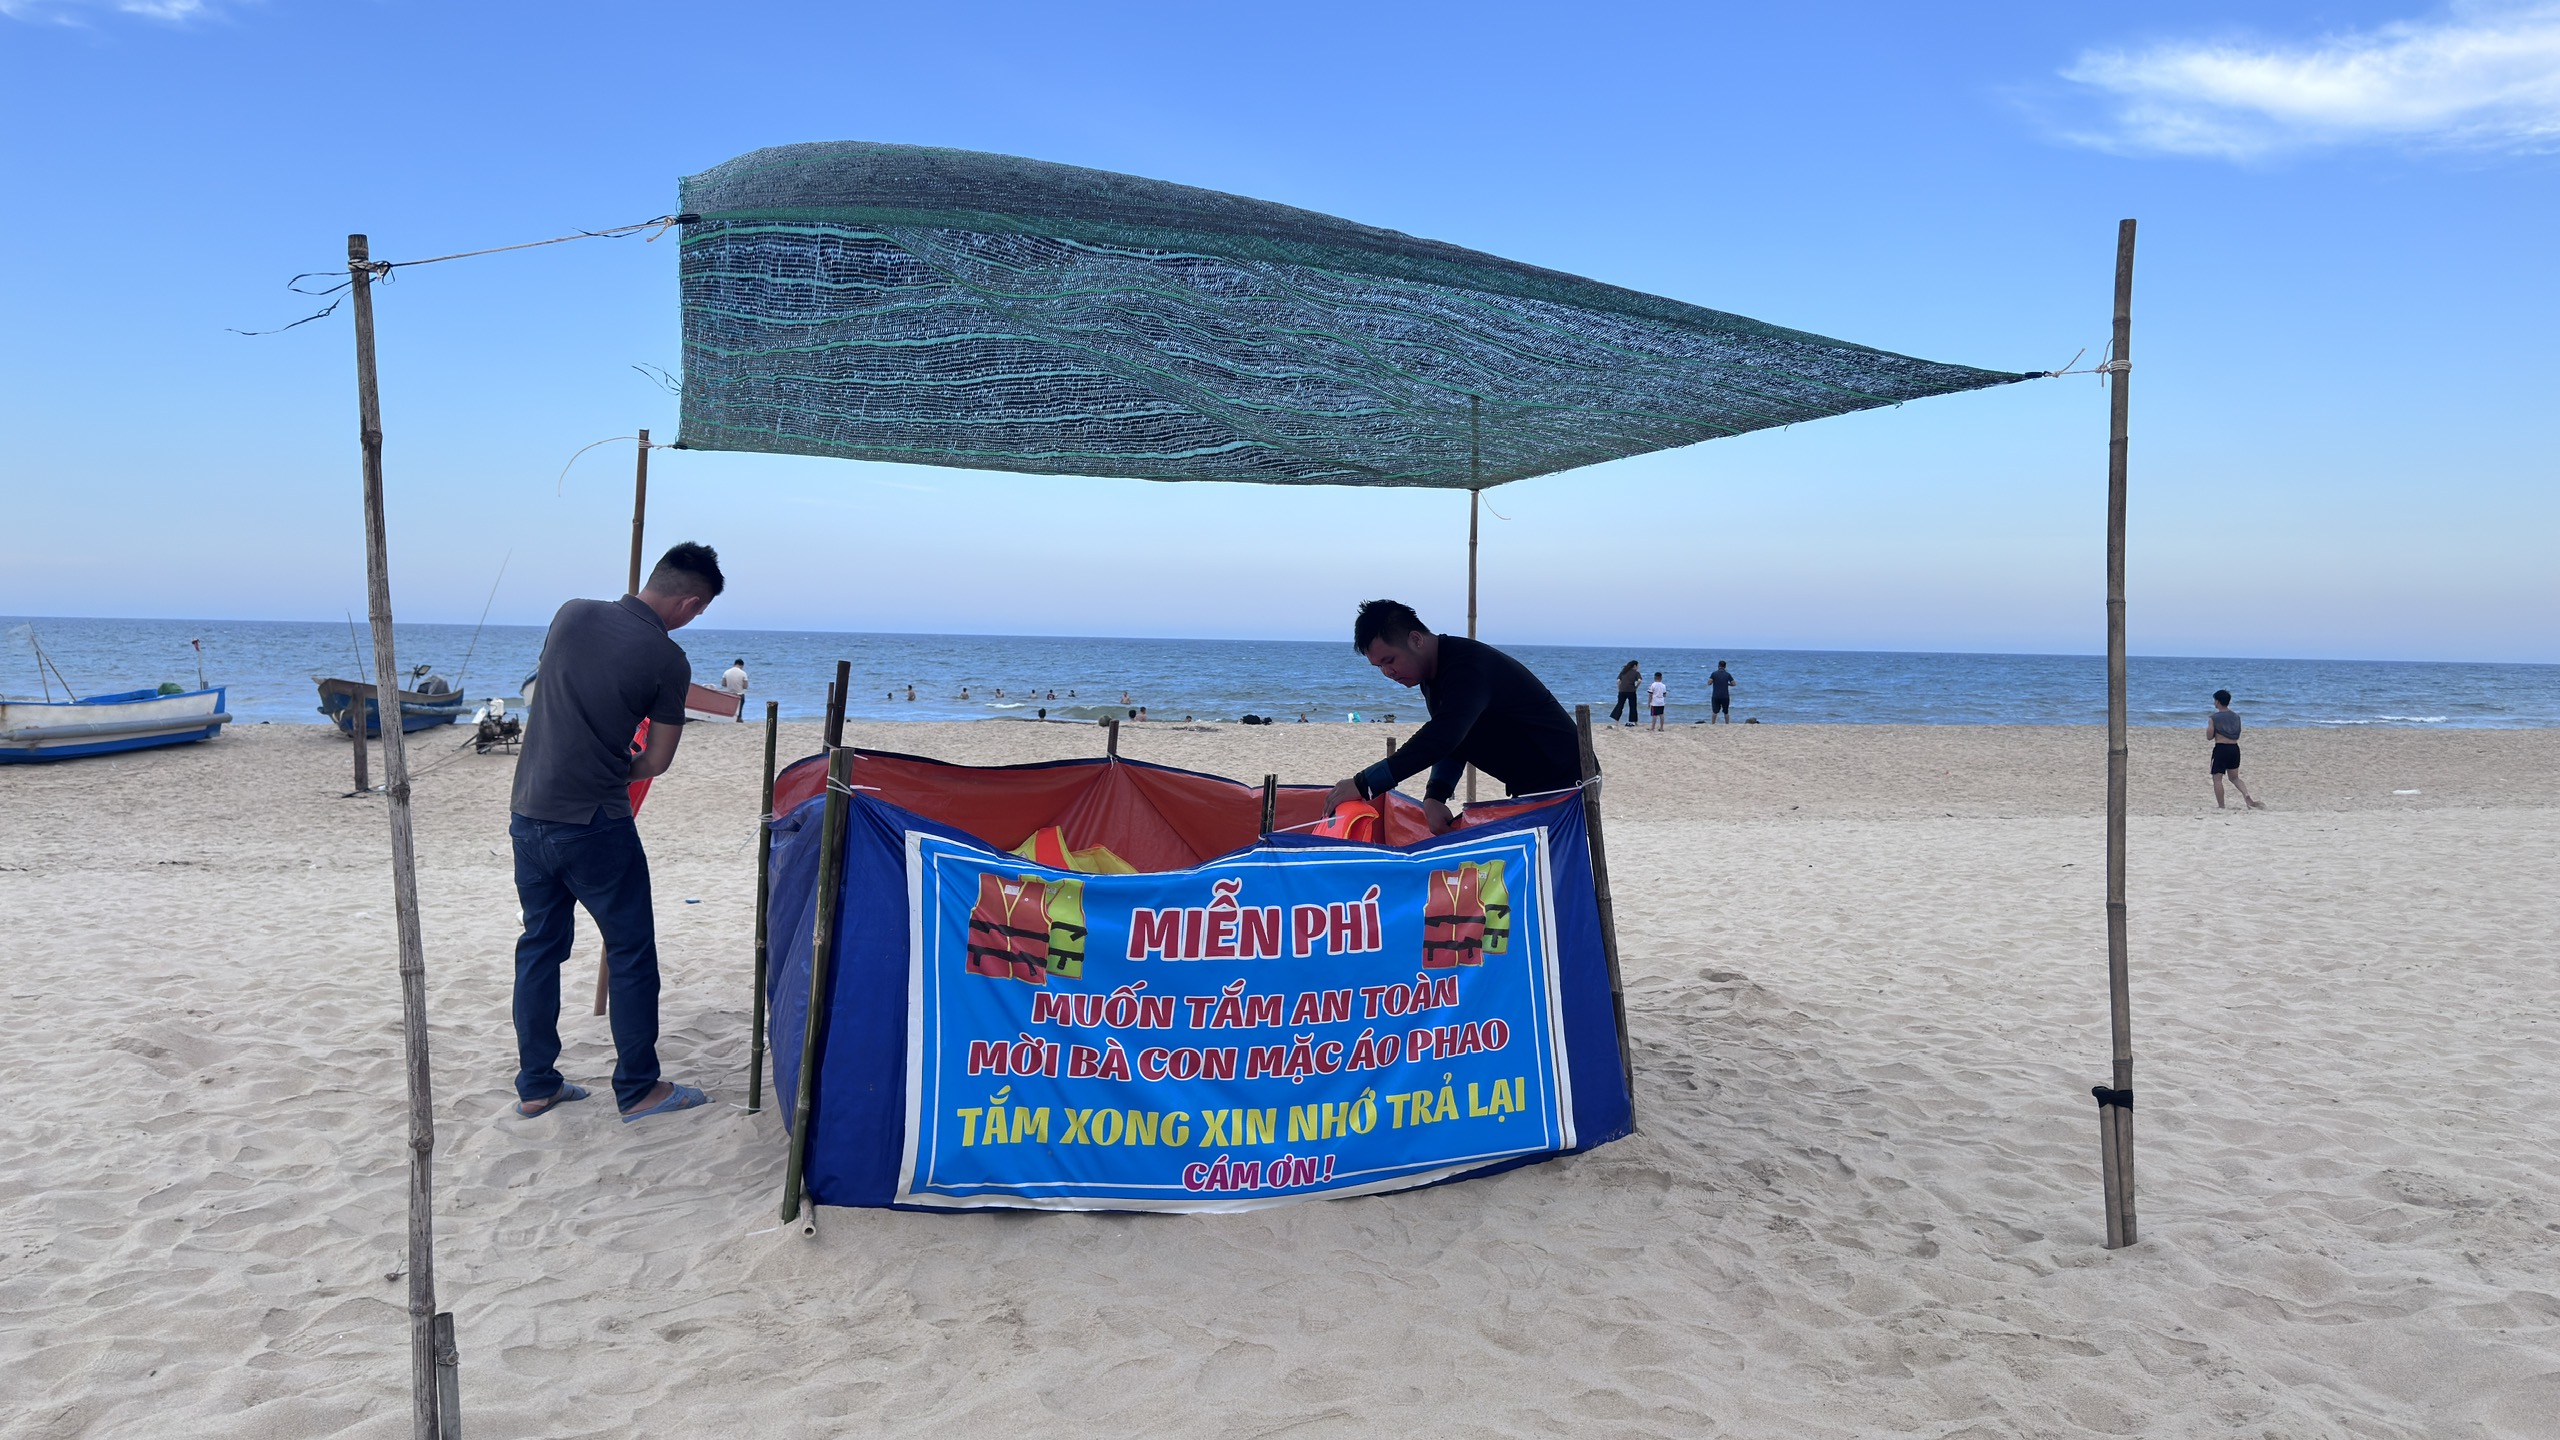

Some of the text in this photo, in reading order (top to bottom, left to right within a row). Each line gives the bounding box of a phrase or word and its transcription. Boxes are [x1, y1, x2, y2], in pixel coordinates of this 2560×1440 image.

[1126, 877, 1382, 962] MIỄN PHÍ
[1031, 972, 1459, 1029] MUỐN TẮM AN TOÀN
[968, 1018, 1510, 1084] MỜI BÀ CON MẶC ÁO PHAO
[957, 1072, 1526, 1147] TẮM XONG XIN NHỚ TRẢ LẠI
[1182, 1154, 1260, 1191] CÁM
